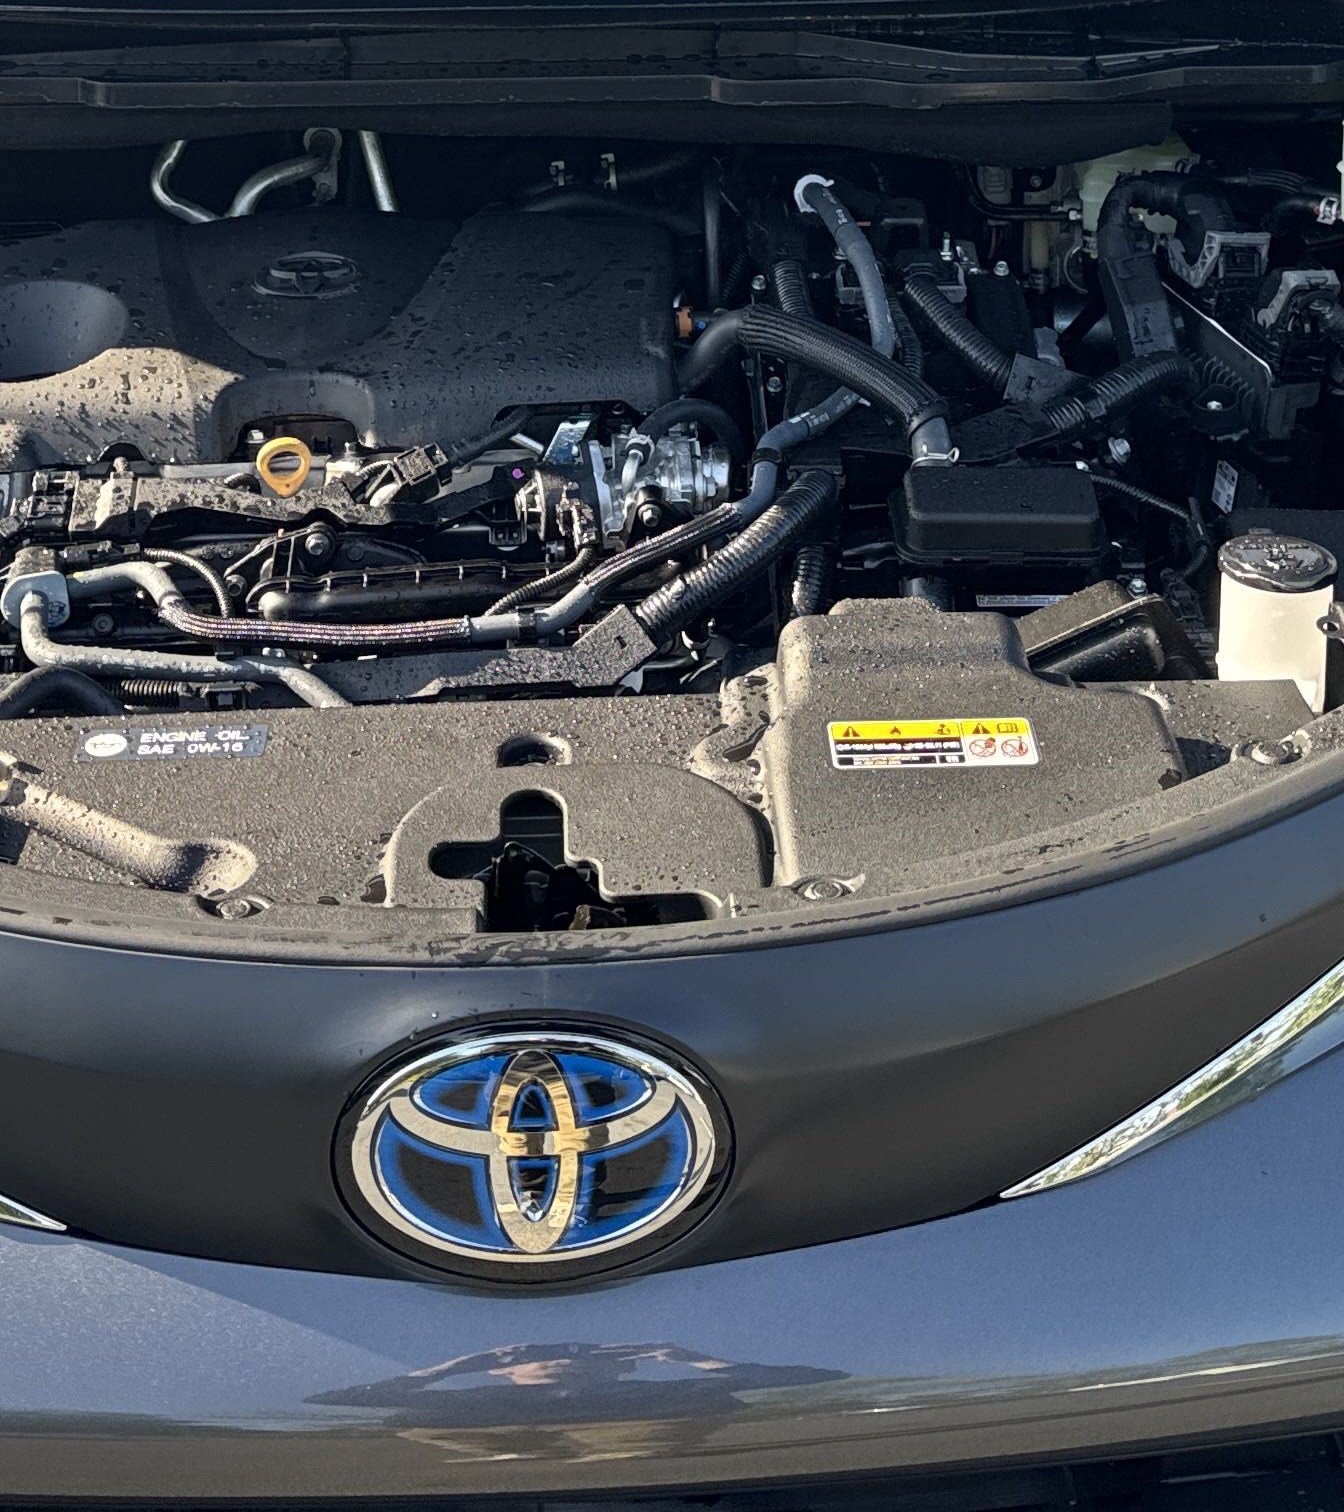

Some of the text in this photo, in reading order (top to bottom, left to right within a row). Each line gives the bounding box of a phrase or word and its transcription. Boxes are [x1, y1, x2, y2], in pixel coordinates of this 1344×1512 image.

[139, 730, 250, 743] ENGINE OIL
[137, 741, 244, 755] SAE 0W-16
